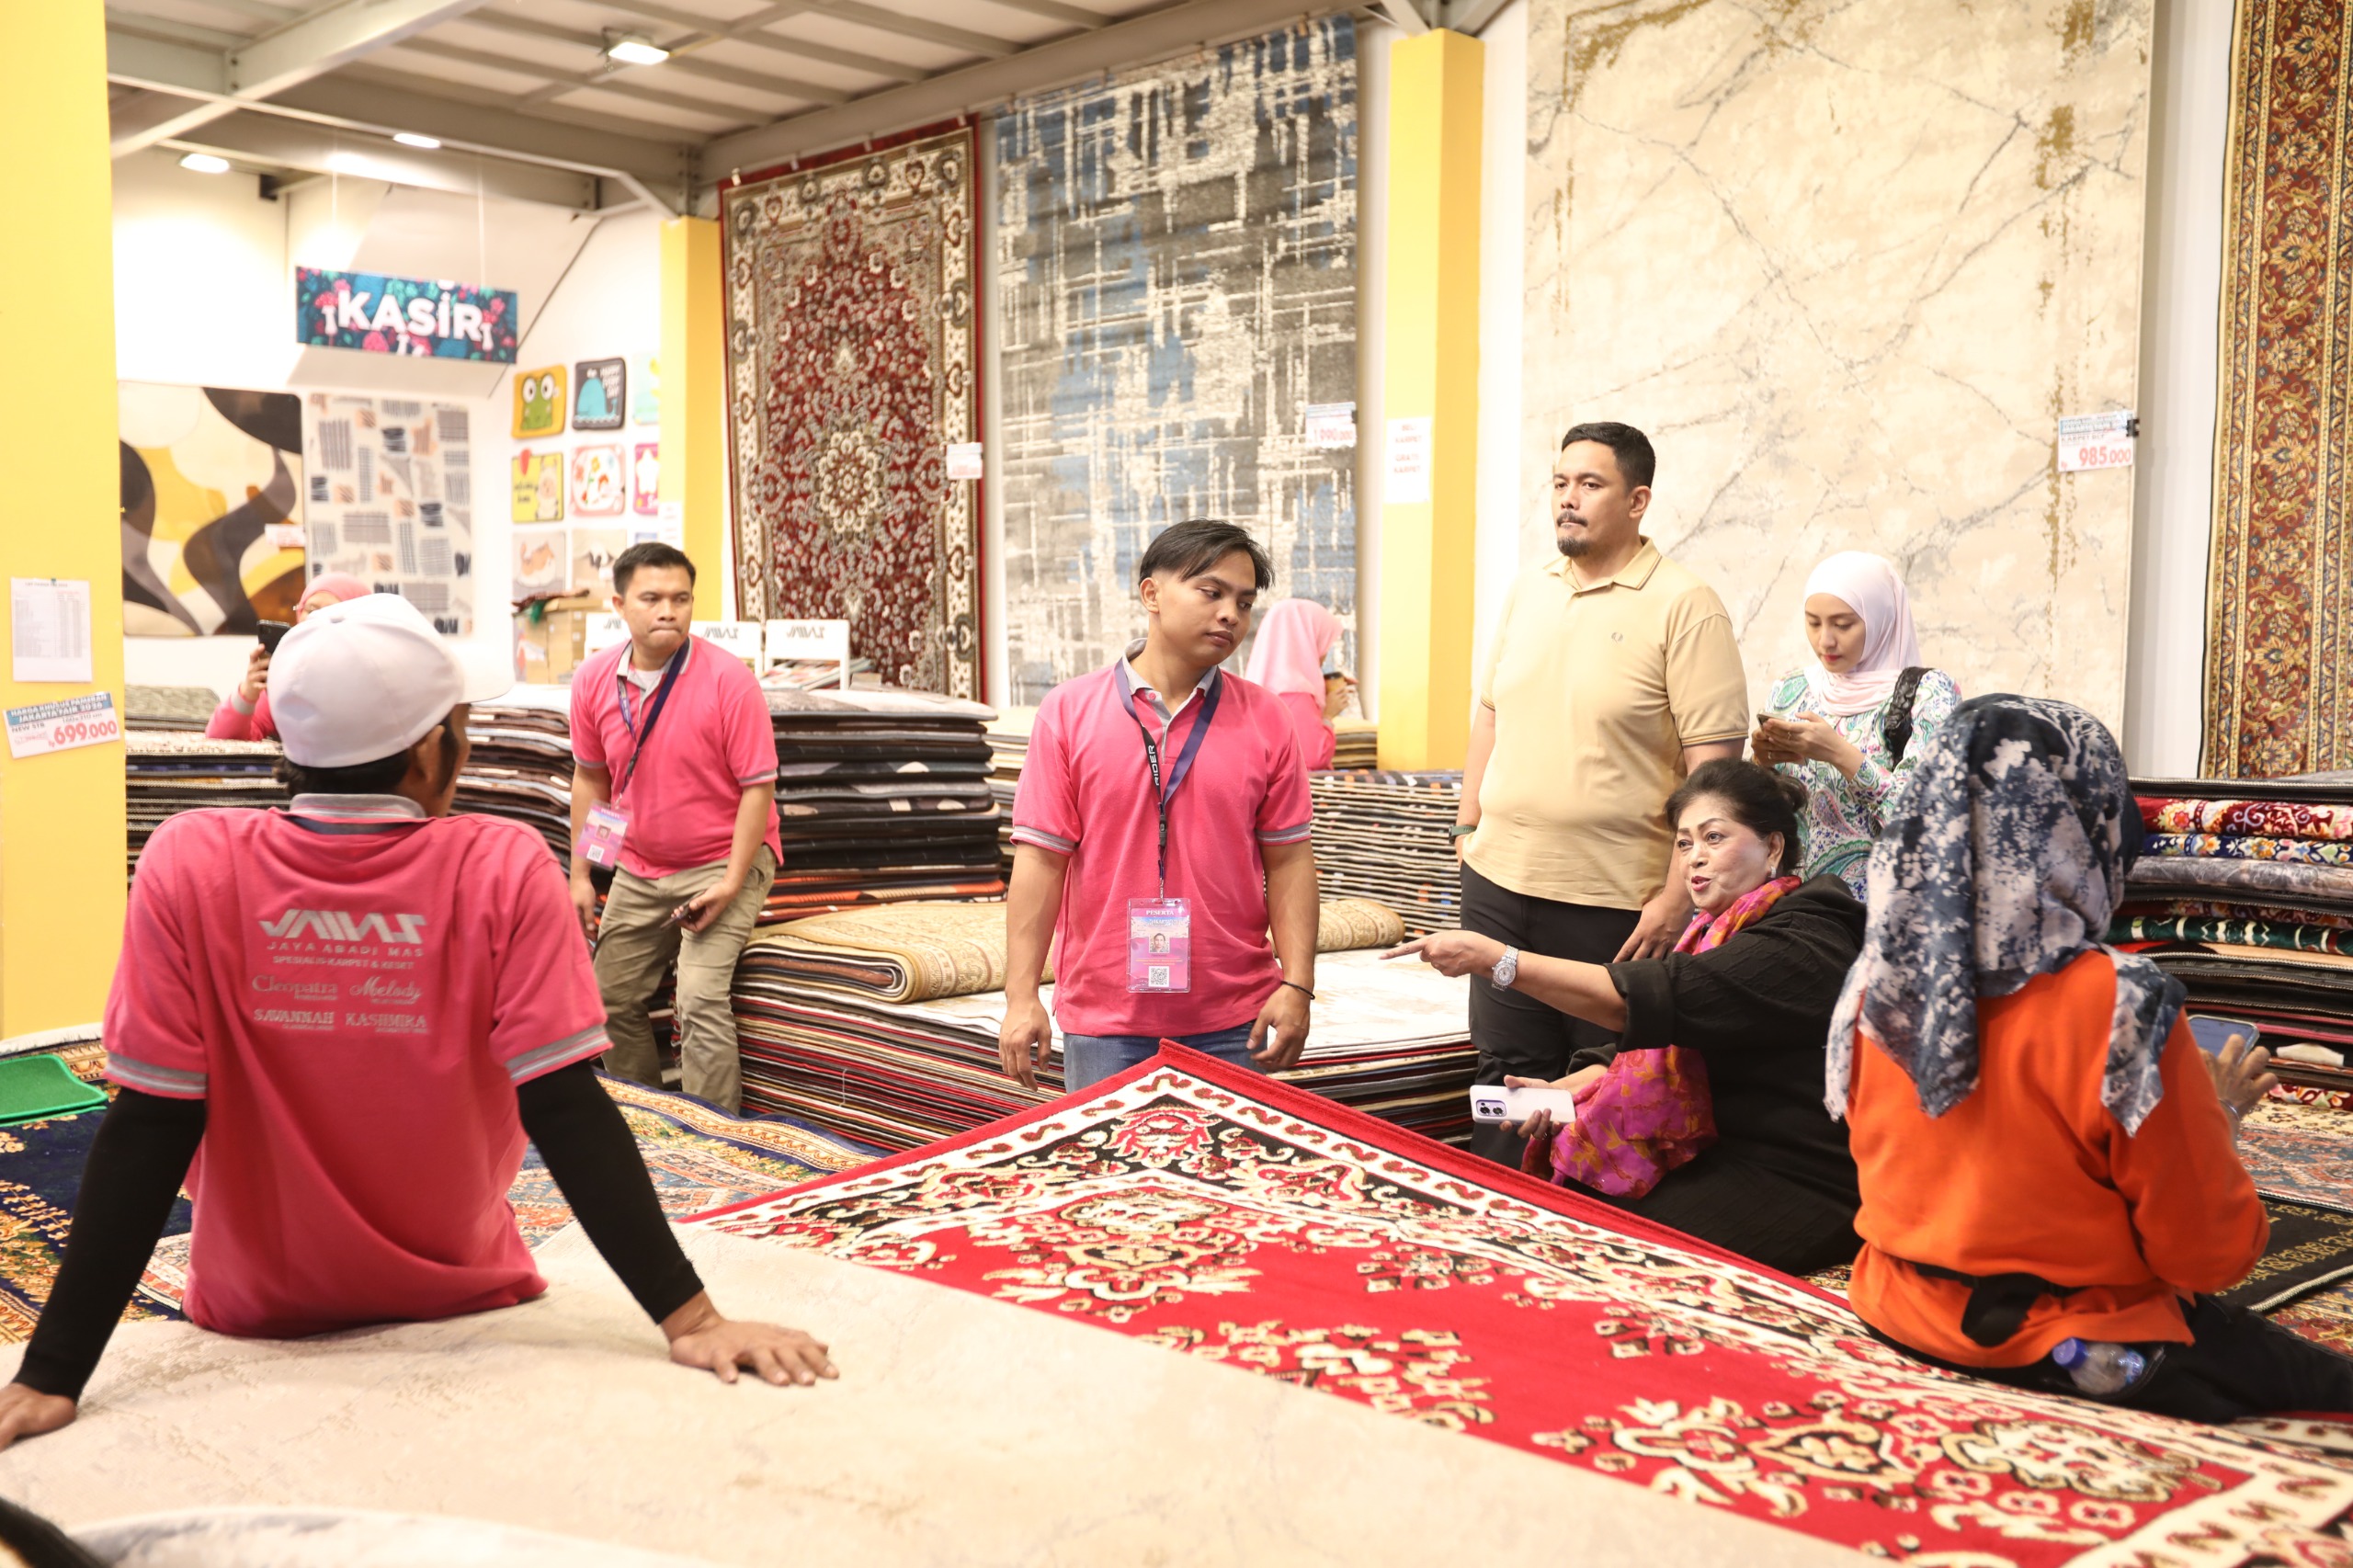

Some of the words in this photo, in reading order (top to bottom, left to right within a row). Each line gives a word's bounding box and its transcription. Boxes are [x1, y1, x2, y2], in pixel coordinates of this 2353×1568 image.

[54, 720, 117, 745] 699.000
[1148, 744, 1160, 786] RIDER
[267, 941, 316, 951] JAYA
[323, 943, 379, 955] ABADI
[388, 947, 424, 958] MAS
[251, 974, 338, 995] Cleopatra
[349, 976, 423, 1002] Melody
[254, 1008, 335, 1024] SAVANNAH
